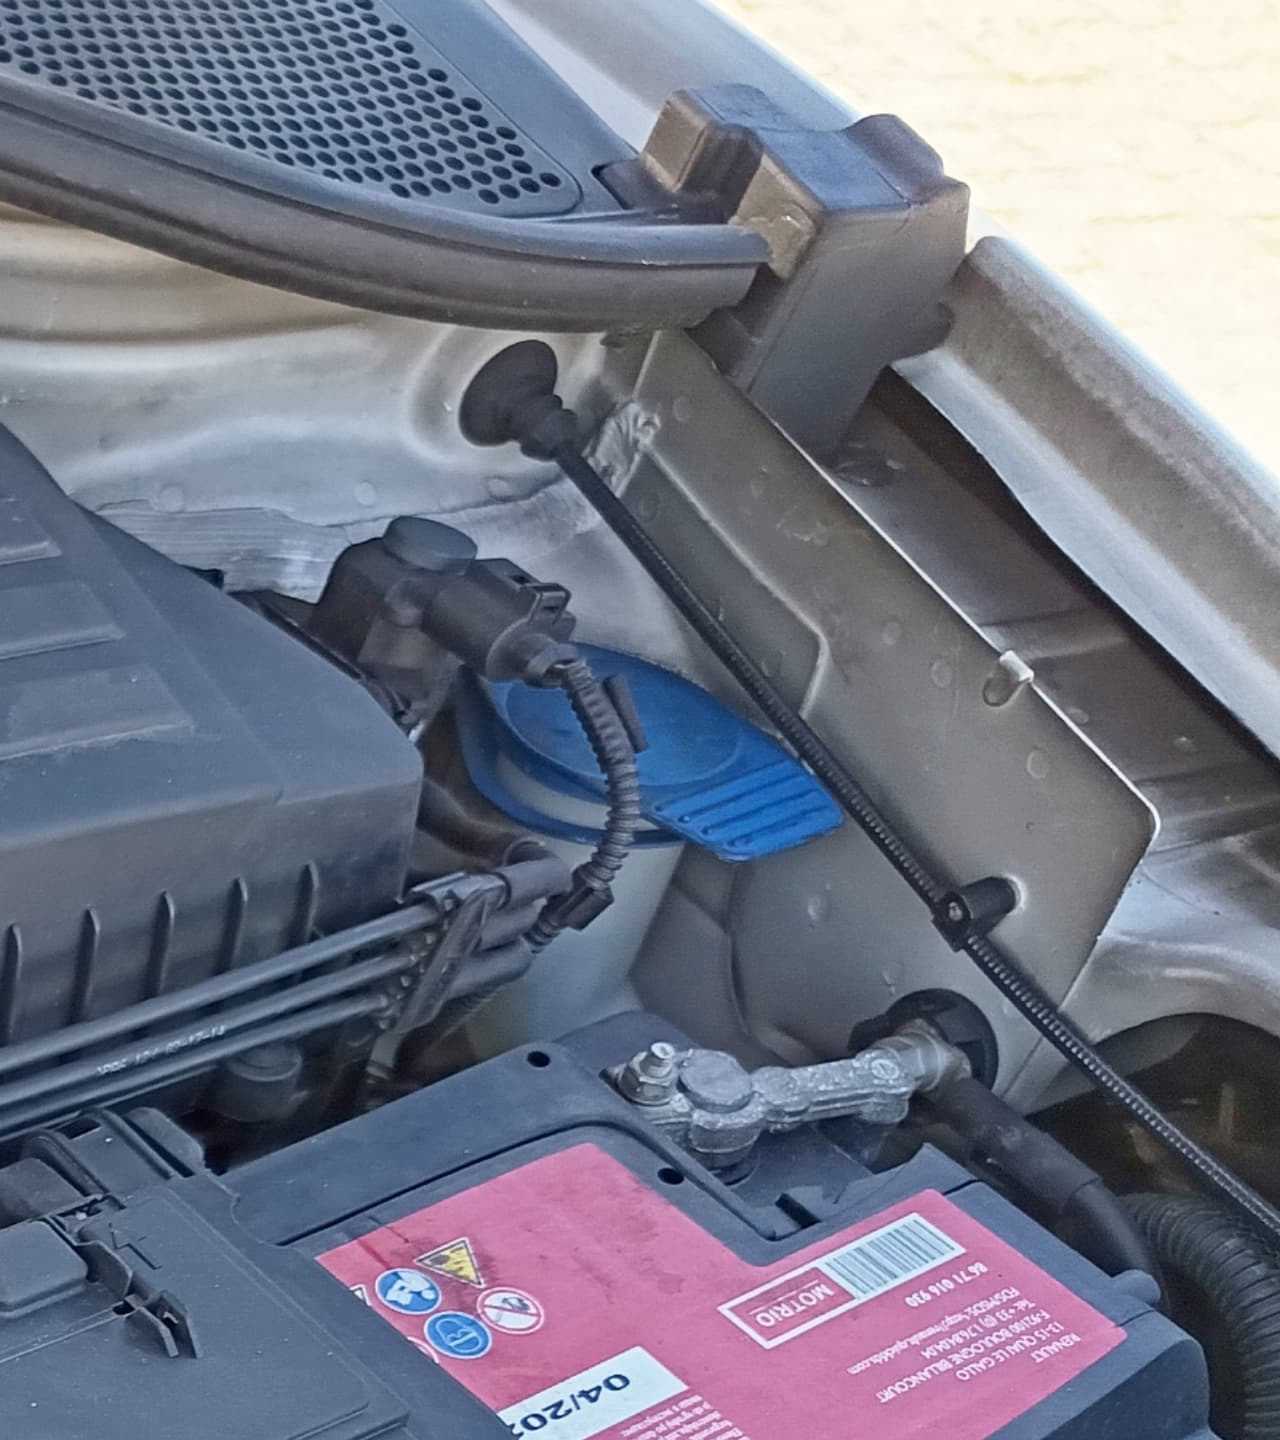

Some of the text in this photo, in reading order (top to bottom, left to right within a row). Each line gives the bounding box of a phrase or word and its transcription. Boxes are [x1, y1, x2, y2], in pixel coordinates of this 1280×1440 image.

[903, 1261, 988, 1307] 86 71 016 930
[874, 1308, 1051, 1404] F-92100 BOULOGNE BILLANCOURT
[954, 1320, 1065, 1381] 13-15 QUAI LE GALLO
[1029, 1331, 1082, 1363] RENAULT
